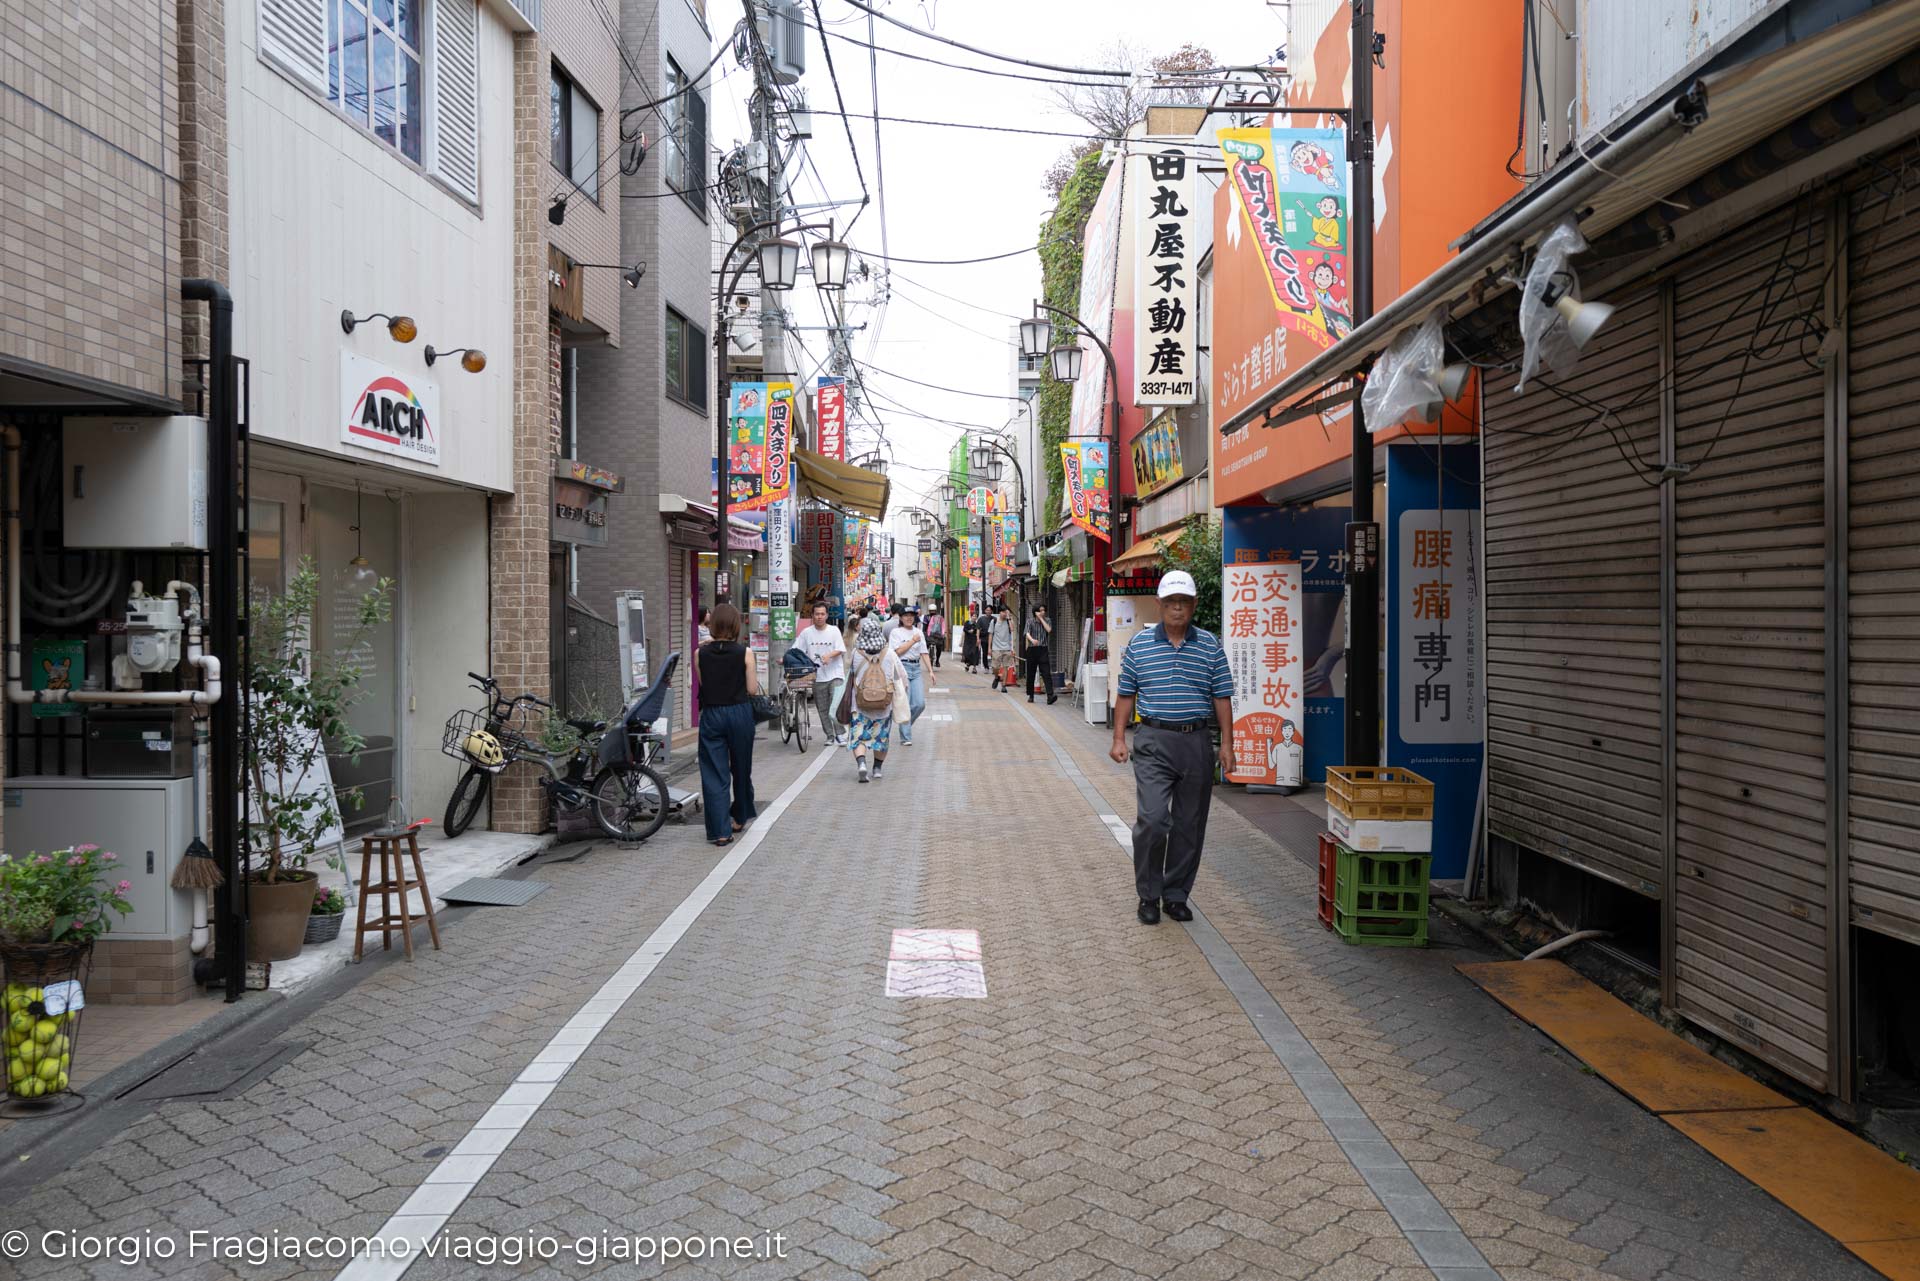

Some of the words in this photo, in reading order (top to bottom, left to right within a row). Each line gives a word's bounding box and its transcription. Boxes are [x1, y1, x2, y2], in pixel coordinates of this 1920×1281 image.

[1148, 149, 1189, 376] 田丸屋不動産
[1141, 382, 1193, 395] 3337-1471
[1221, 326, 1288, 408] ぷらす整骨院
[362, 392, 424, 440] ARCH
[402, 440, 415, 448] HAIR
[416, 442, 437, 455] DESIGN
[769, 404, 788, 484] 四大まつり
[773, 508, 783, 568] 窪田クリニック
[1230, 571, 1258, 638] 治療
[1412, 529, 1454, 723] 腰痛専門
[1261, 570, 1291, 709] 交通事故
[1254, 724, 1273, 735] 理由
